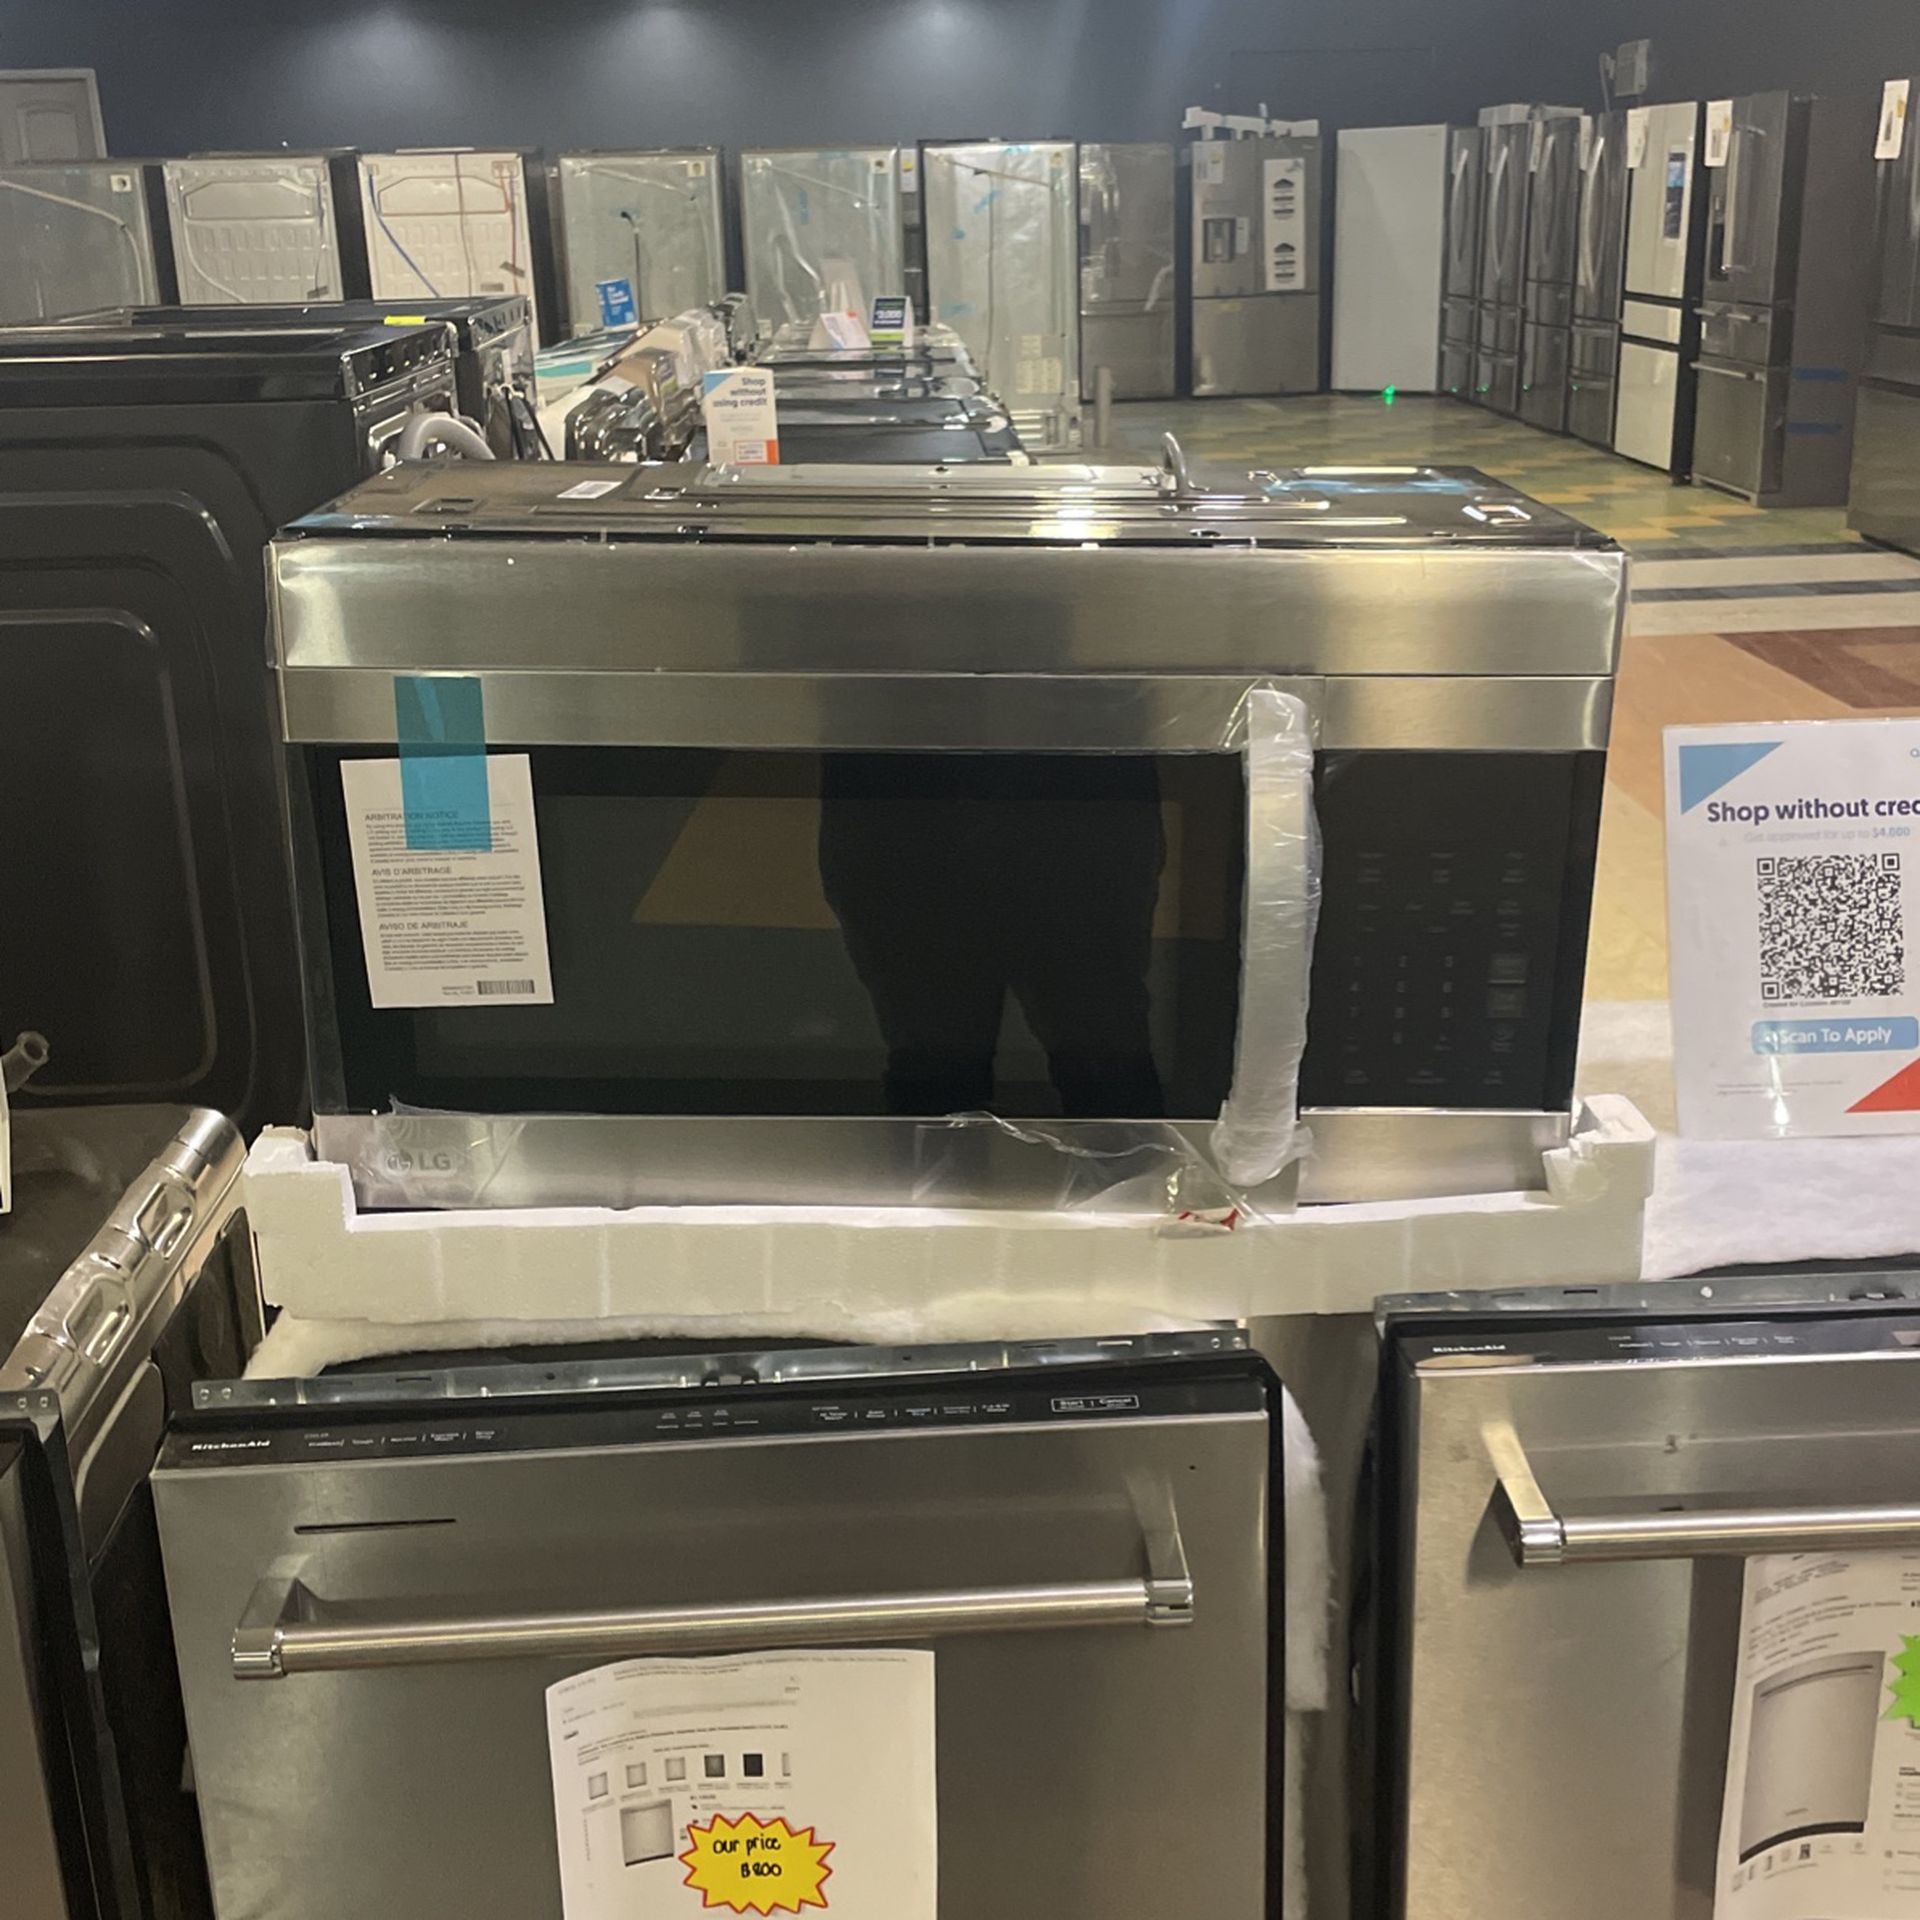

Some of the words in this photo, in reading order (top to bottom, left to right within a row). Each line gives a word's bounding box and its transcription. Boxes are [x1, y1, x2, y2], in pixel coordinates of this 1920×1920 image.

[365, 812, 424, 821] ARBITRAION
[1707, 801, 1769, 825] Shop
[1775, 798, 1870, 819] without
[379, 922, 405, 931] AVISO
[407, 922, 418, 930] DE
[420, 920, 469, 929] ARBITRAJE
[1779, 1029, 1817, 1045] Scan
[1822, 1028, 1841, 1042] To
[1845, 1026, 1892, 1045] Apply
[418, 1150, 451, 1171] LG
[1432, 1344, 1506, 1353] KitchenAid
[192, 1440, 270, 1451] KitchenAid
[746, 1832, 782, 1856] price
